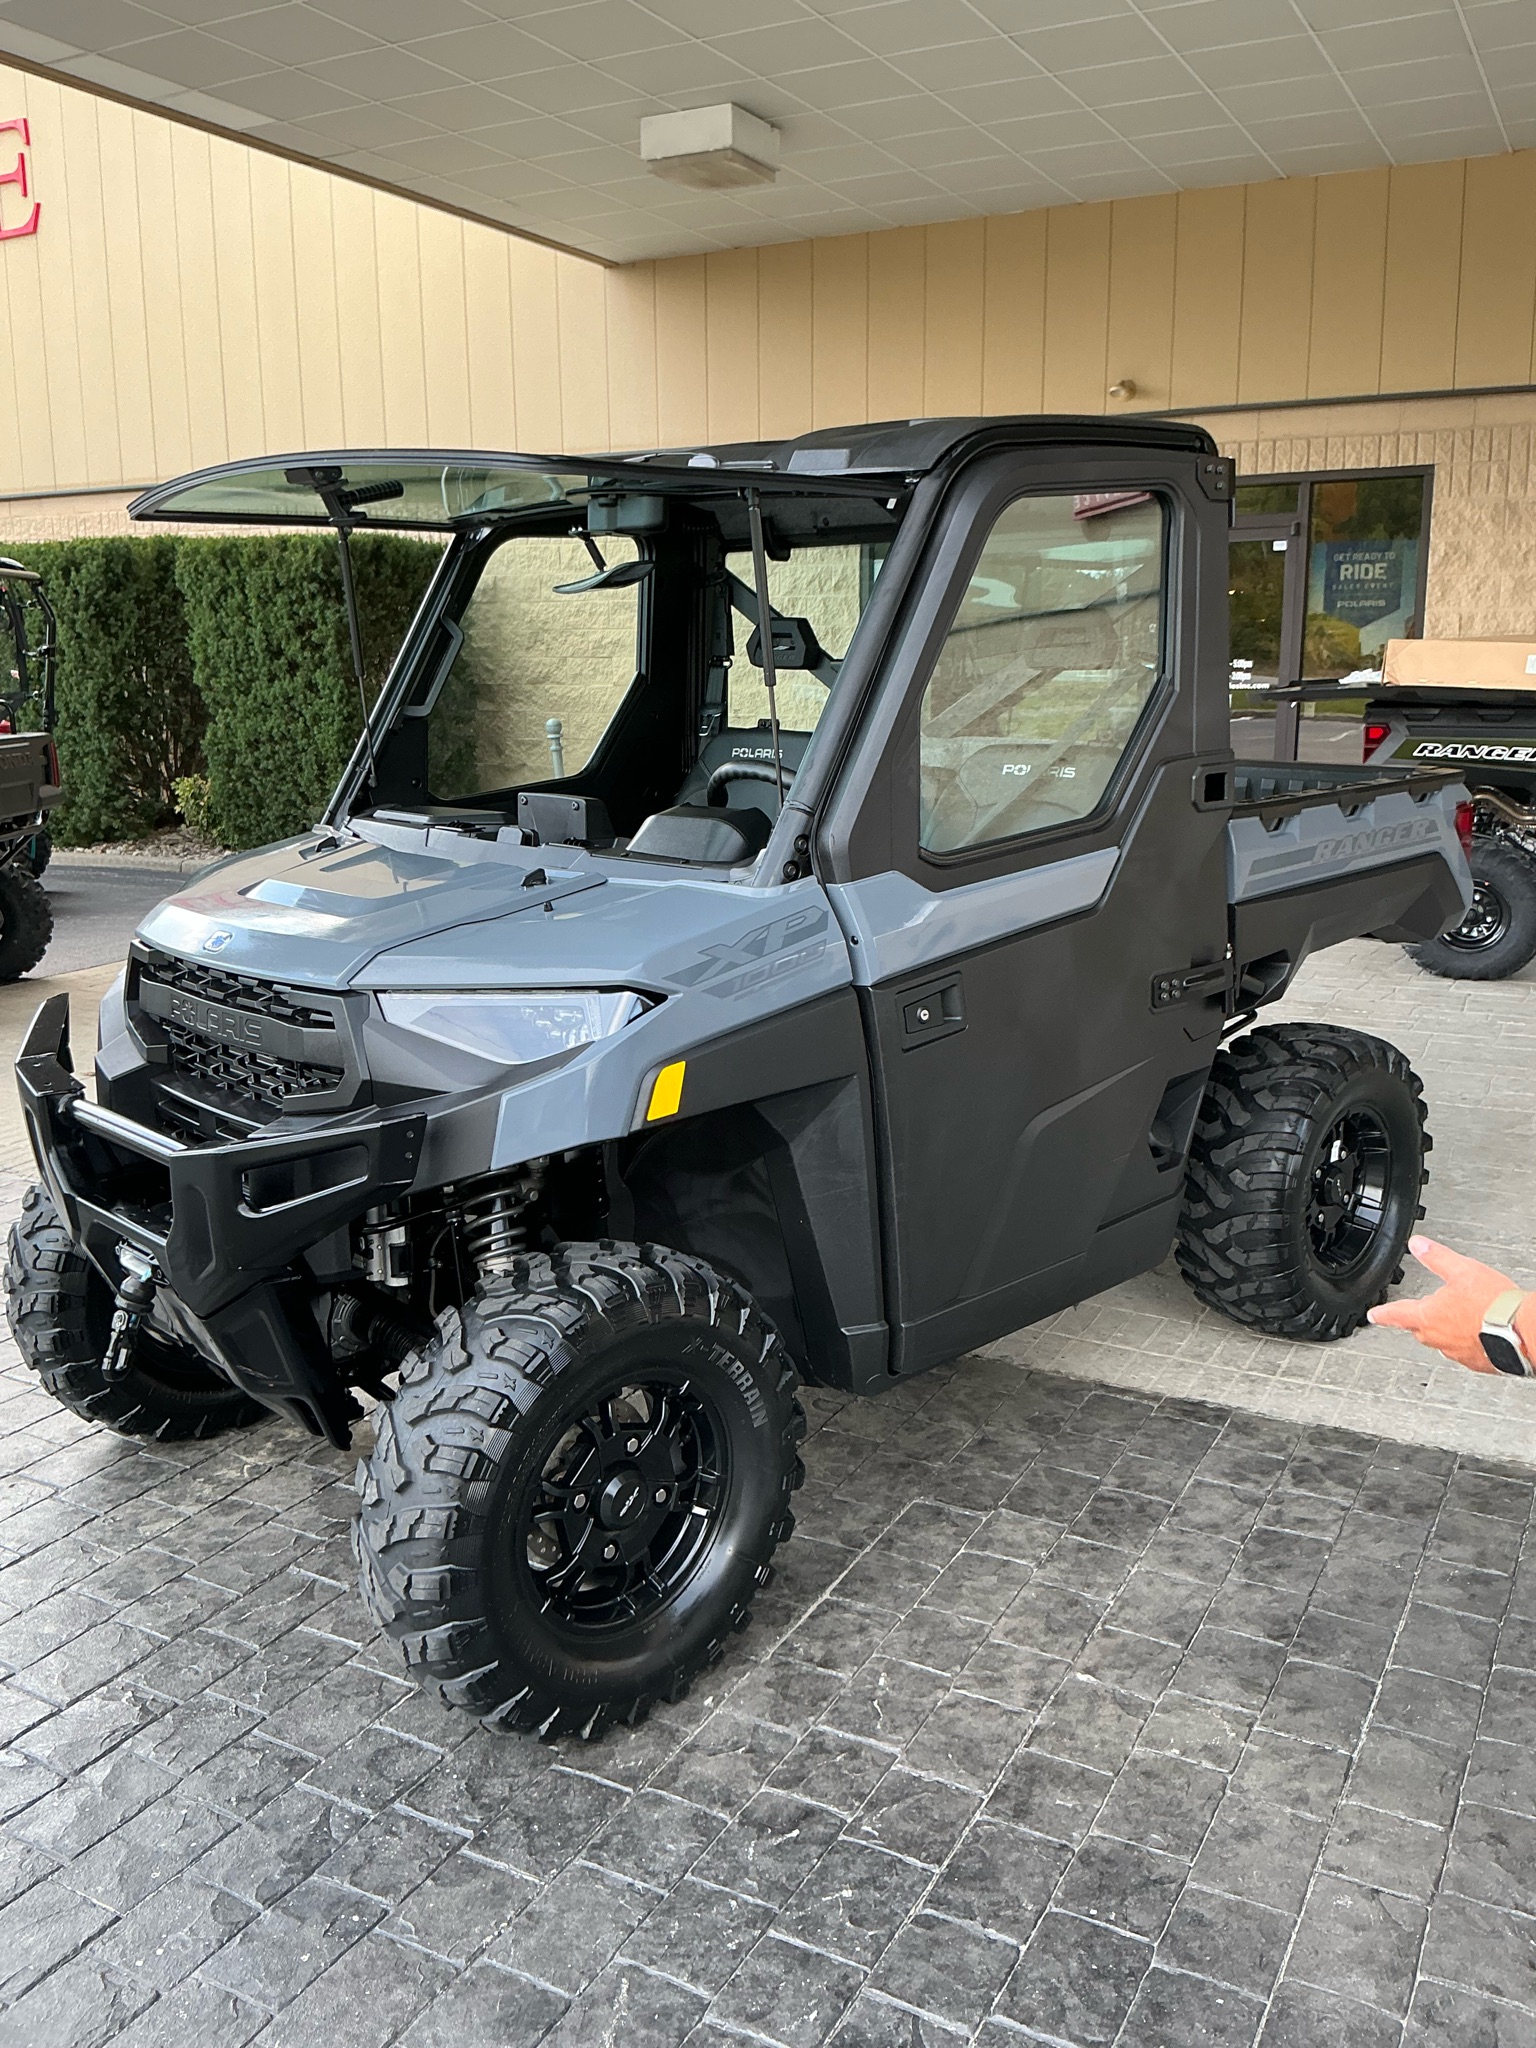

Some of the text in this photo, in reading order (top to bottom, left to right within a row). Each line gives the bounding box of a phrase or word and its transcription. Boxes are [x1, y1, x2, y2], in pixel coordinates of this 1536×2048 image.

[1340, 562, 1387, 581] RIDE
[1352, 552, 1381, 561] READY
[1337, 599, 1386, 608] POLARIS
[1312, 818, 1431, 865] RANGER
[688, 904, 829, 987] XP
[171, 998, 262, 1046] POLARIS
